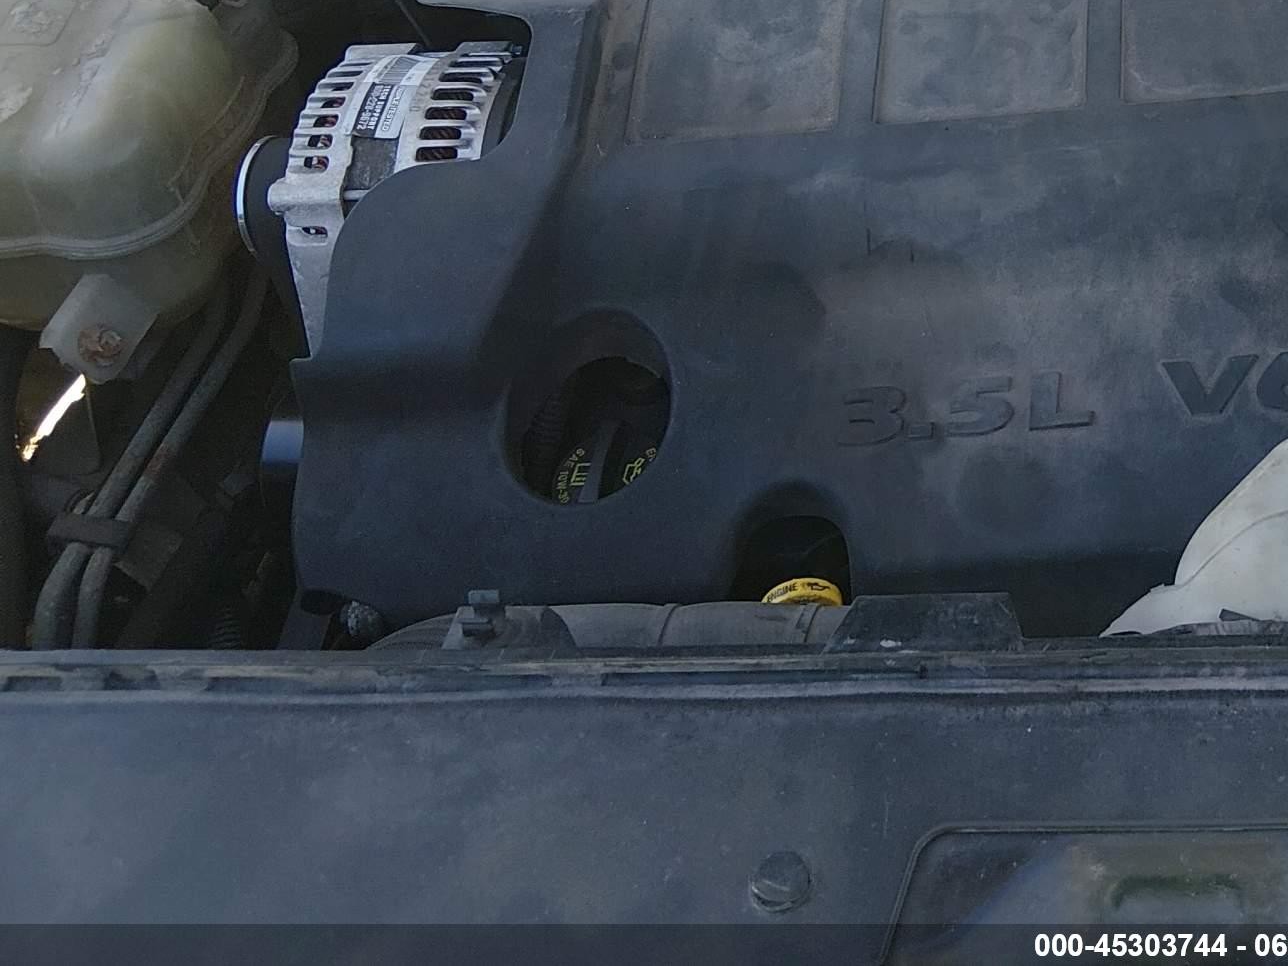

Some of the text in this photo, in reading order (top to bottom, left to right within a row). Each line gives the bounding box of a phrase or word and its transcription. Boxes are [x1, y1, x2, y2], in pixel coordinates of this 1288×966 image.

[367, 85, 392, 130] TECH SUPPORT
[836, 370, 1097, 447] 3.5L
[766, 582, 799, 603] ENGINE
